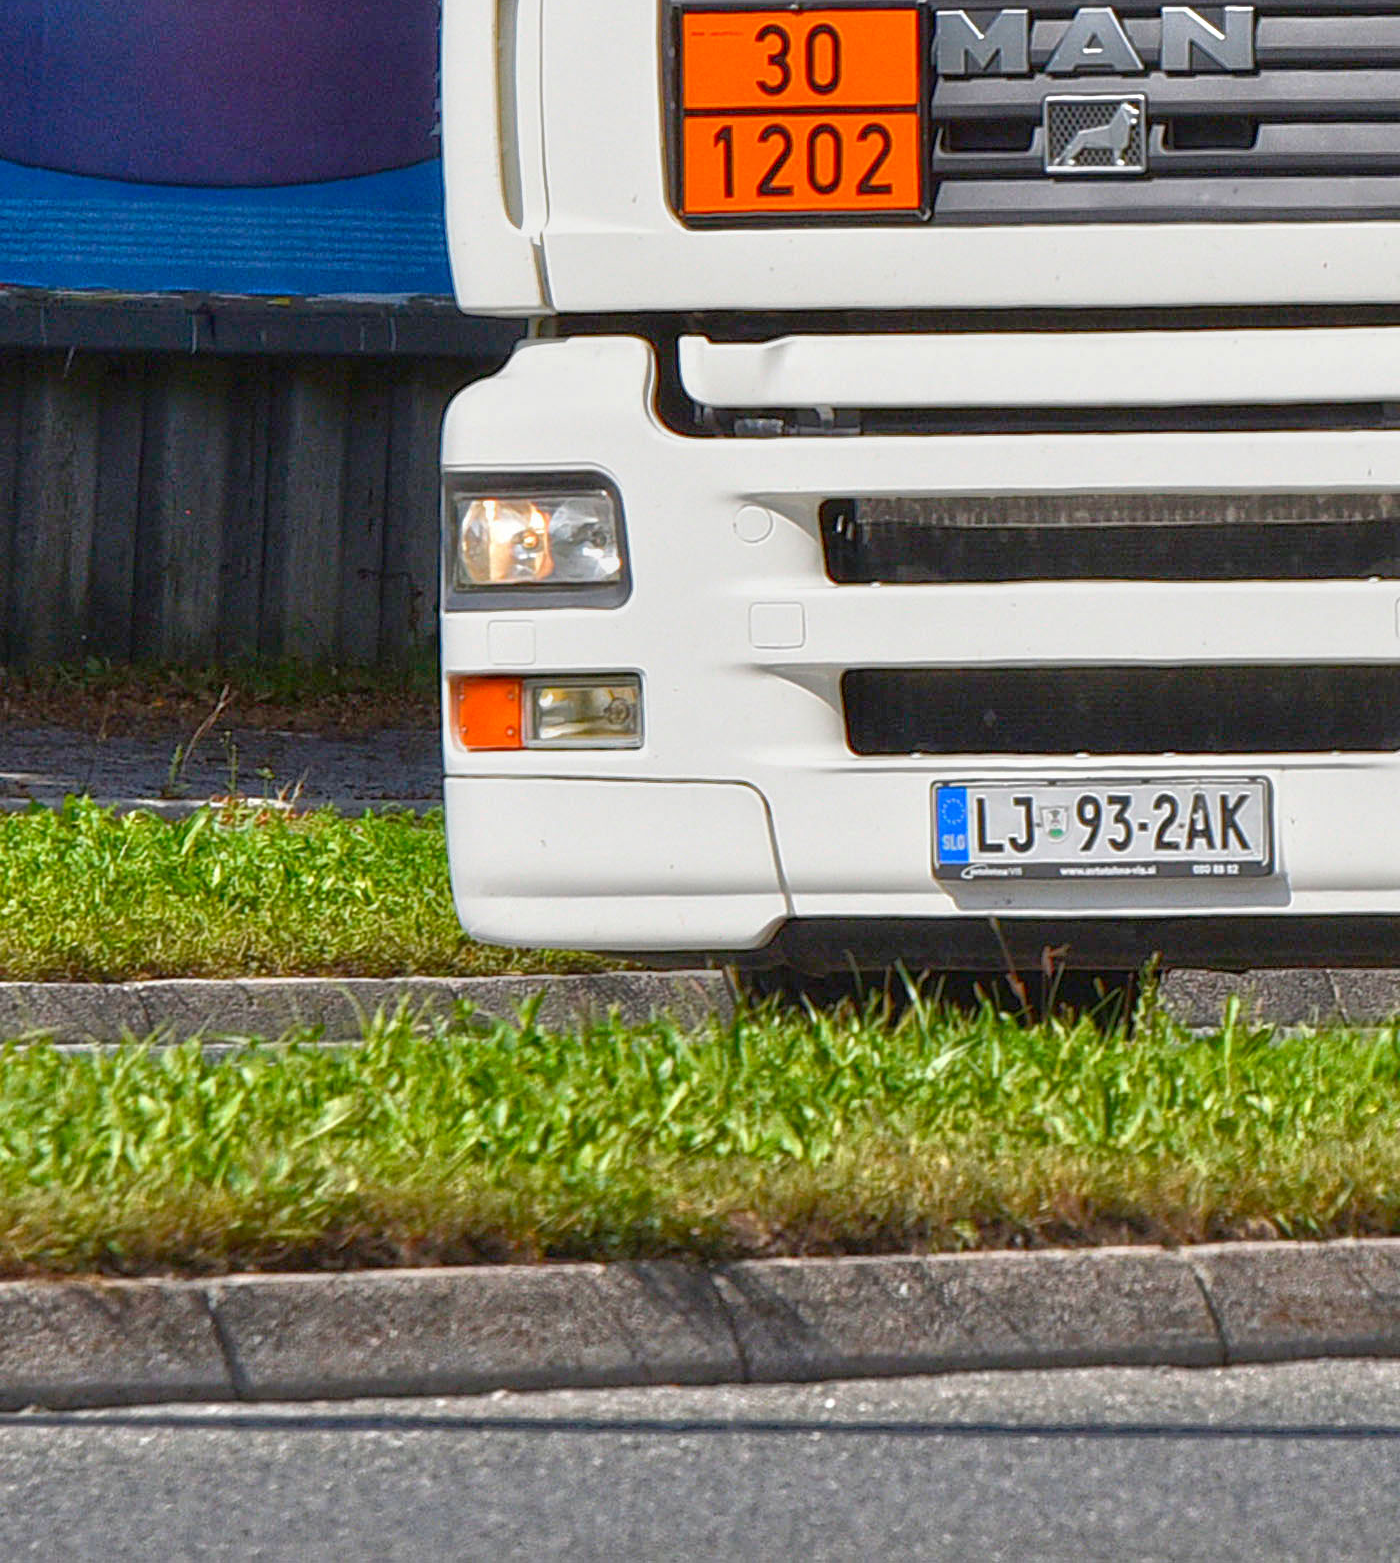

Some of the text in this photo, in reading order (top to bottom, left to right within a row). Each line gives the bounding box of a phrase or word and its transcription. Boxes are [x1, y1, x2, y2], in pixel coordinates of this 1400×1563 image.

[753, 23, 843, 97] 30
[934, 6, 1255, 76] MAN
[712, 123, 895, 201] 1202
[976, 795, 1035, 853] LJ
